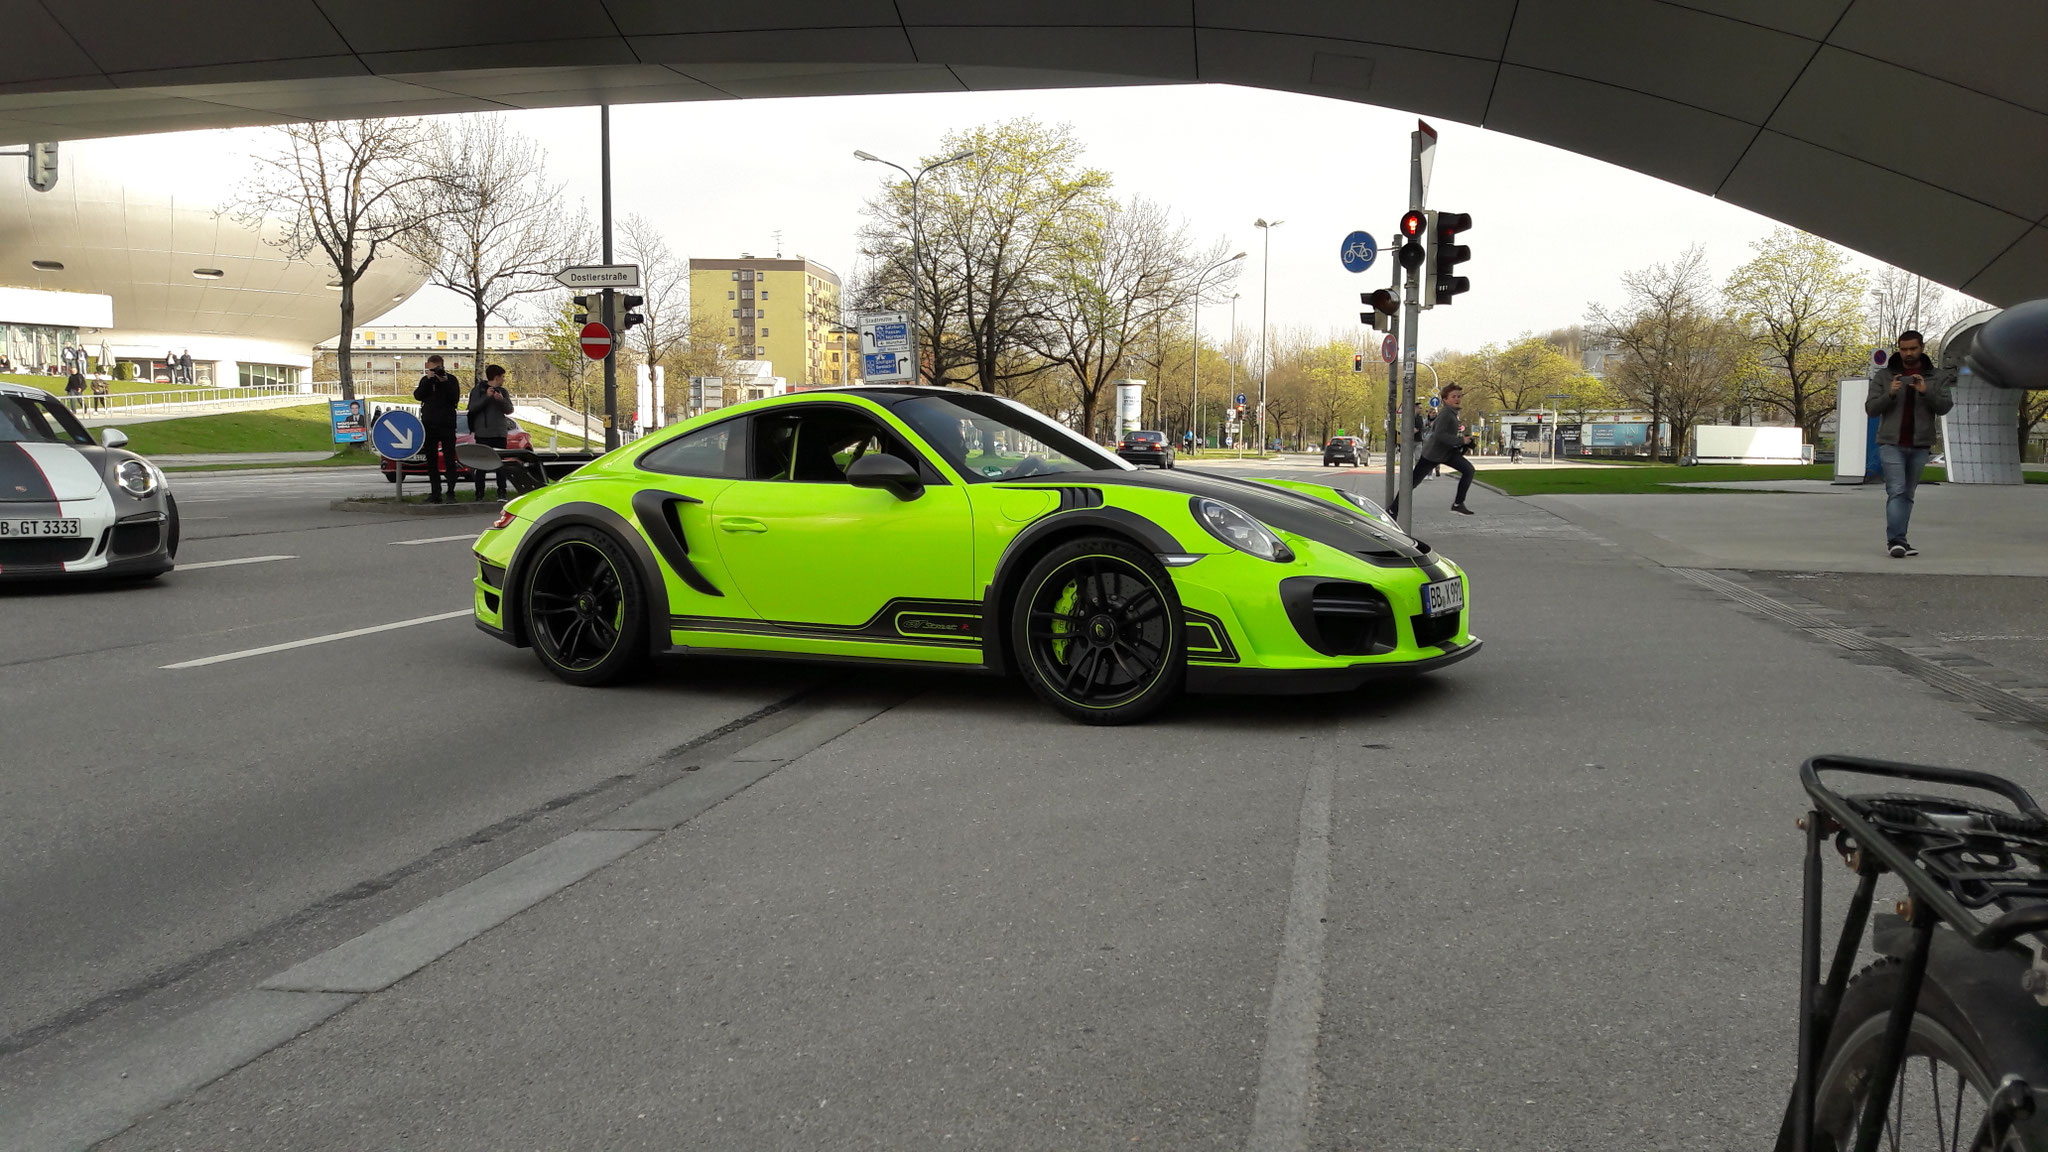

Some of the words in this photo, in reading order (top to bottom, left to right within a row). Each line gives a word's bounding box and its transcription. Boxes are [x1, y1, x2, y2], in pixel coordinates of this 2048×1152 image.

[571, 273, 628, 282] Dostlerstraße
[20, 521, 39, 535] GT
[43, 520, 78, 534] 3333
[1430, 586, 1442, 609] BB
